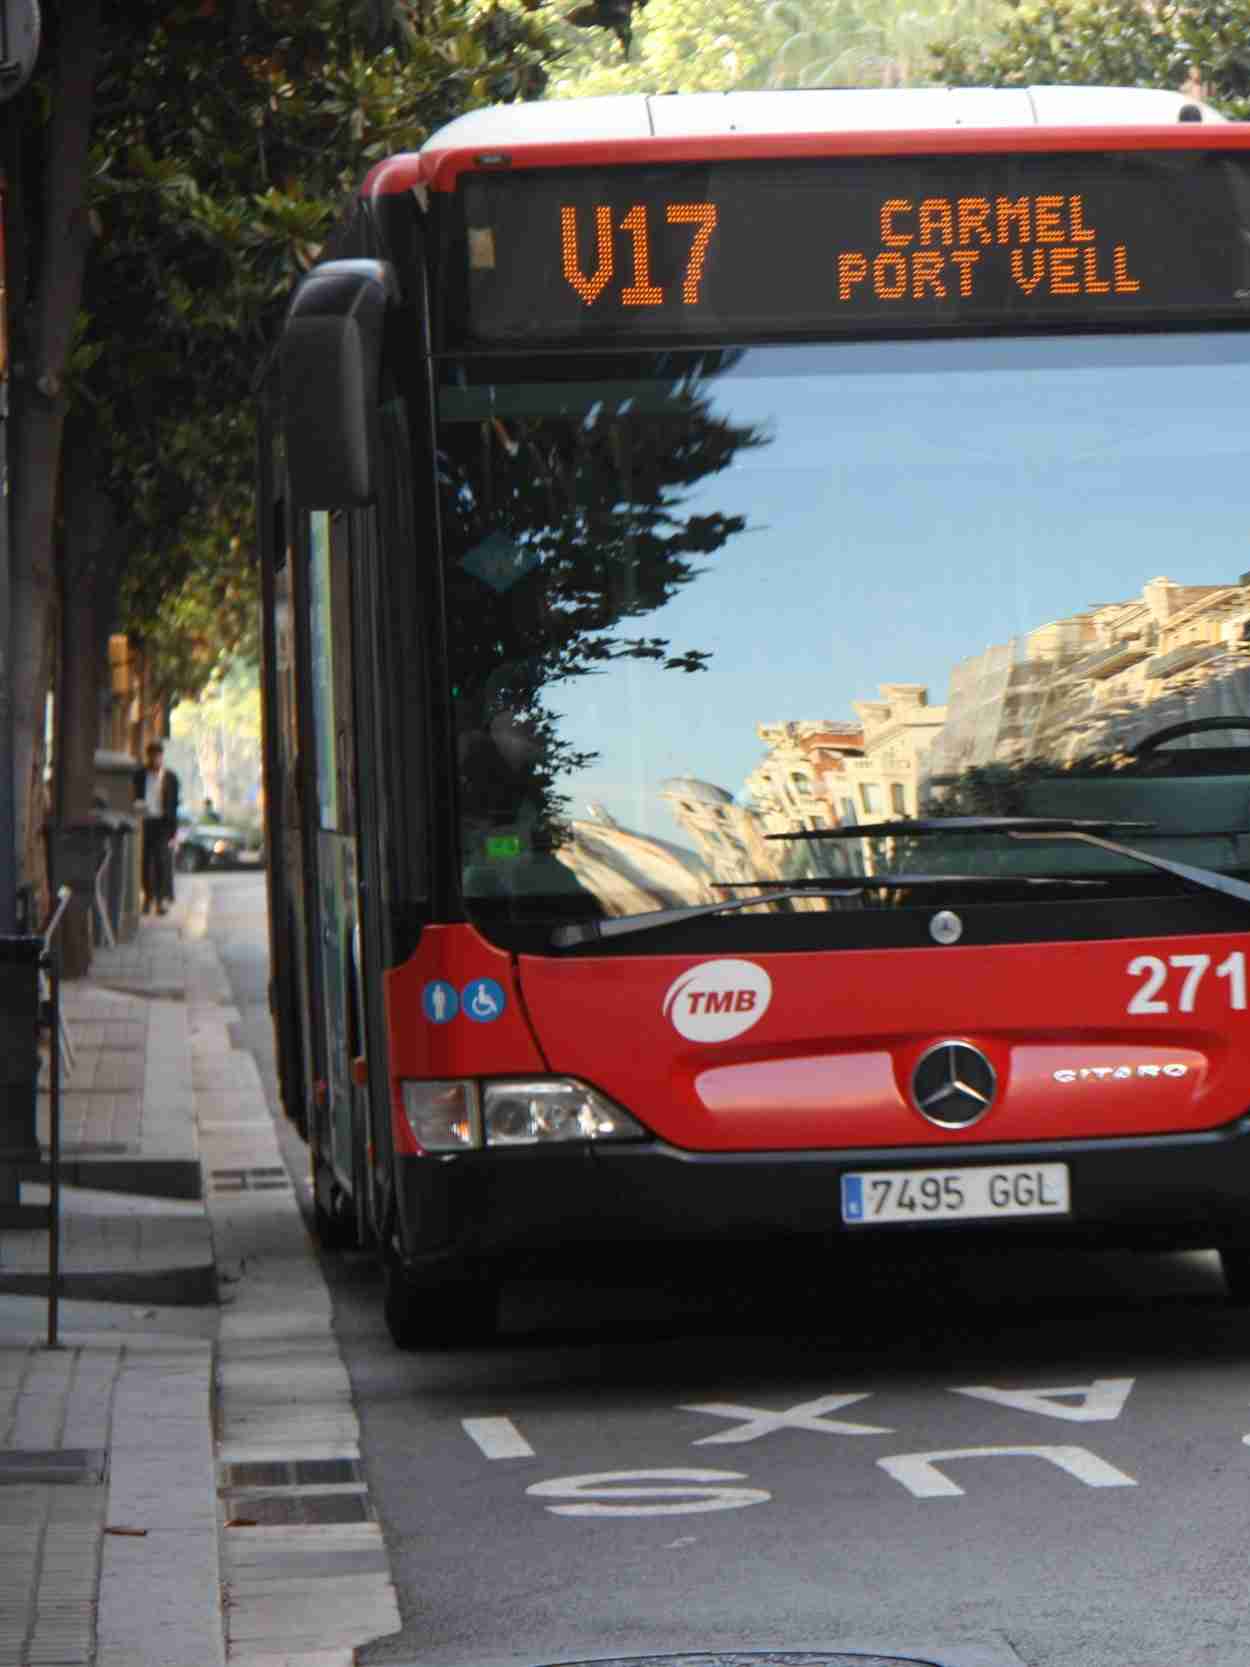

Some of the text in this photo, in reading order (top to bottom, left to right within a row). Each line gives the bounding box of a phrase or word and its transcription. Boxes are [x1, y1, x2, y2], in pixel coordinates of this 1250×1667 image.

[879, 194, 1096, 247] CARMEL
[559, 202, 718, 306] V17
[838, 245, 1140, 301] PORT VELL
[687, 988, 757, 1015] TMB
[871, 1176, 965, 1216] 7495
[989, 1171, 1058, 1207] GGL
